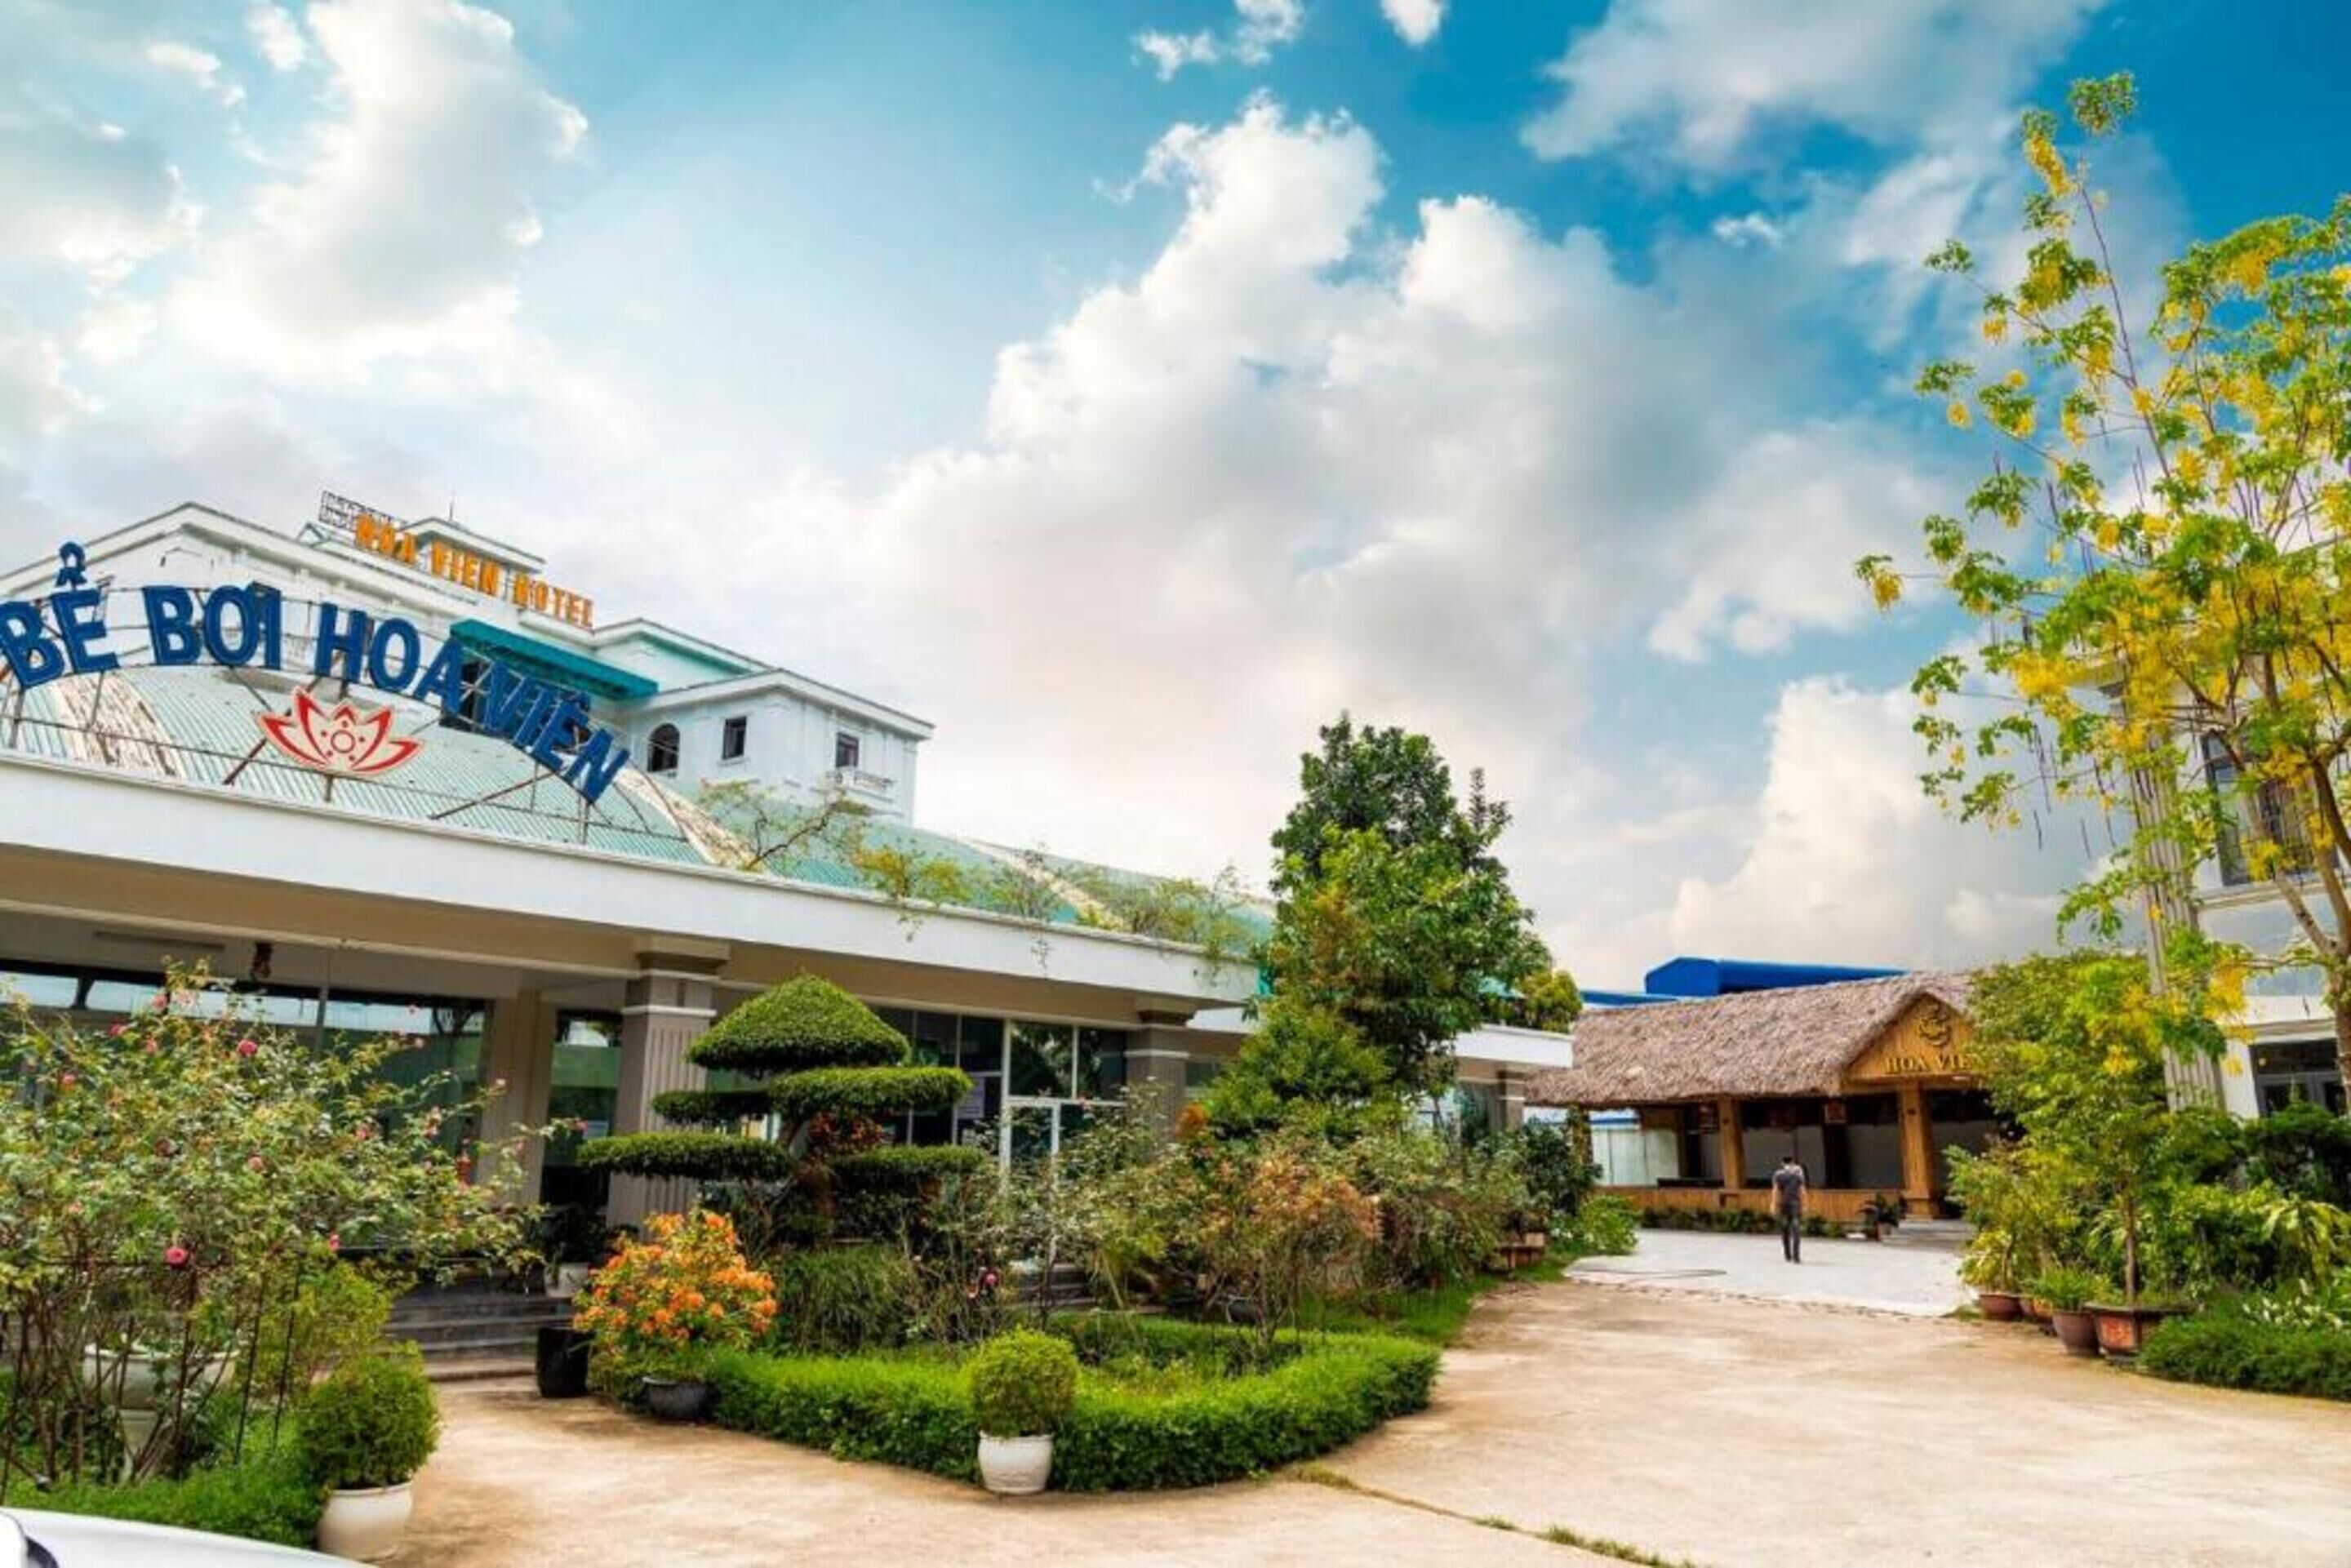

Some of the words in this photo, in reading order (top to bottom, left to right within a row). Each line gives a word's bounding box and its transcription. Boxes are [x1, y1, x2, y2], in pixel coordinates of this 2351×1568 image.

[513, 571, 594, 627] HOTEL
[314, 602, 462, 714] HOA
[1885, 1057, 1928, 1073] HOA
